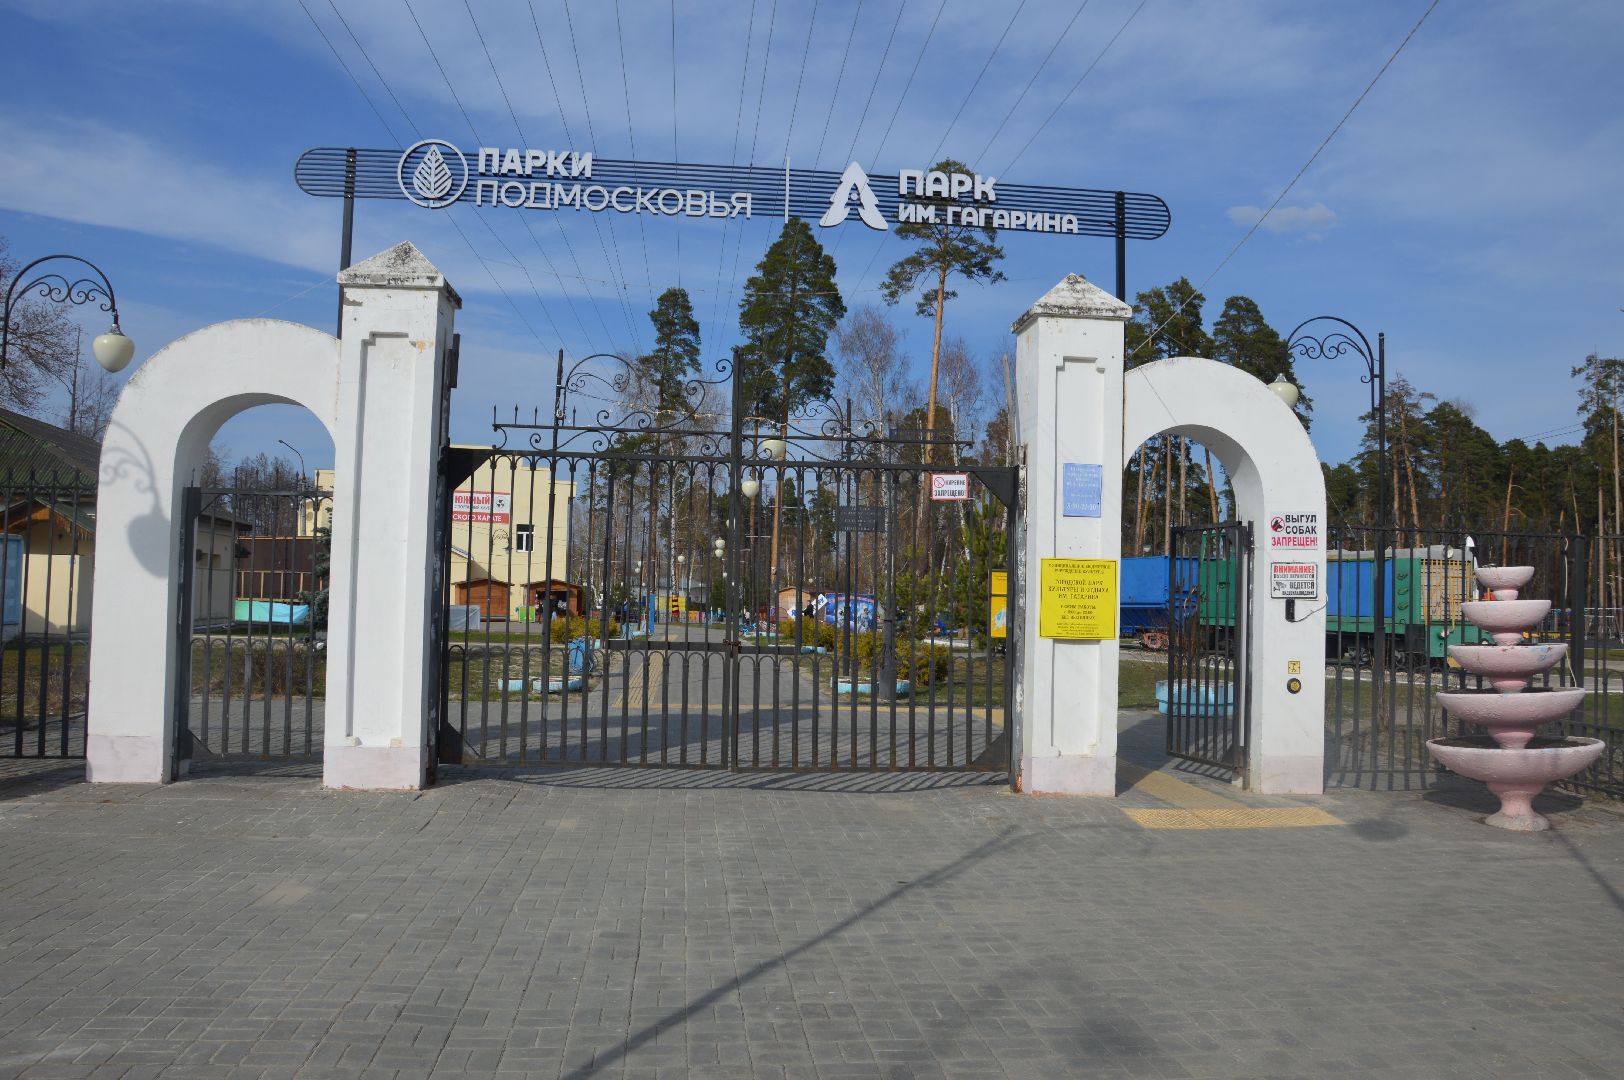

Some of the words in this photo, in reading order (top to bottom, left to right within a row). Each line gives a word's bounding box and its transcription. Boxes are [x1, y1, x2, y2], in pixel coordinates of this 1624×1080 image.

[478, 147, 593, 179] ПАРКИ
[898, 168, 997, 201] ПАРК
[476, 180, 752, 218] ПОДМОСКОВЬЯ
[898, 203, 941, 224] ИМ.
[946, 206, 1079, 234] ГАГАРИНА
[1285, 514, 1317, 523] ВЫГУЛ
[1285, 525, 1317, 535] СОБАК
[1271, 536, 1318, 547] ЗАПРЕЩЕН!
[1273, 565, 1315, 574] ВНИМАНИЕ!
